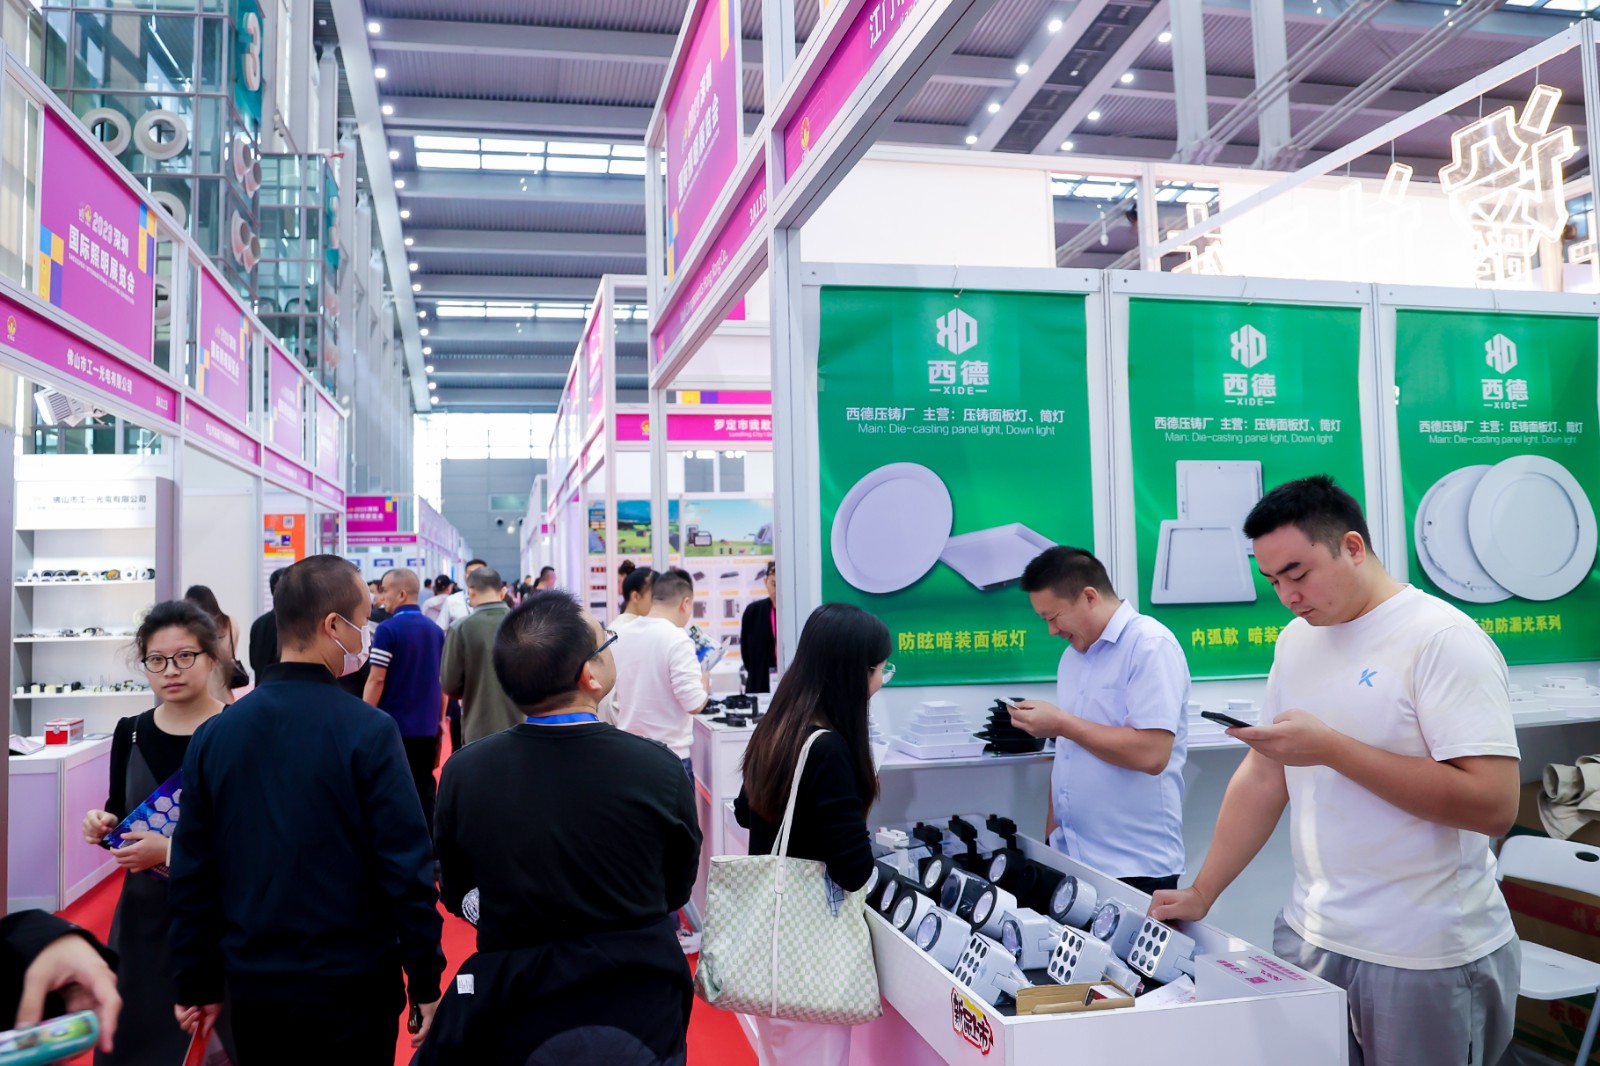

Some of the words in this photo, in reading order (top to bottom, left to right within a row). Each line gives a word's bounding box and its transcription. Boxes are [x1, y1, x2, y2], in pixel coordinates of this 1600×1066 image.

[68, 223, 135, 295] 国际照明展览会
[67, 348, 133, 397] 佛山市工一光电有限公司
[928, 360, 989, 386] 西德
[943, 386, 975, 396] XIDE
[1223, 373, 1277, 398] 西德
[1480, 378, 1529, 401] 西德
[1237, 397, 1264, 407] XIDE
[1494, 401, 1517, 410] XIDE
[846, 407, 915, 421] 西德压铸厂
[1154, 416, 1214, 431] 西德压铸厂
[858, 423, 886, 434] Main:
[889, 423, 949, 436] Die-casting
[951, 425, 979, 435] panel
[981, 424, 1004, 436] light,
[1006, 424, 1034, 435] Down
[1036, 425, 1055, 436] light
[1192, 432, 1243, 444] Die-casting
[1244, 434, 1268, 444] panel
[1291, 433, 1315, 443] Down
[1316, 434, 1333, 444] light
[1474, 615, 1561, 634] 边防漏光系列
[898, 629, 1027, 651] 防眩暗装面板灯
[1191, 627, 1239, 647] 内弧款
[1247, 626, 1285, 644] 暗装
[952, 993, 994, 1048] 新品上市
